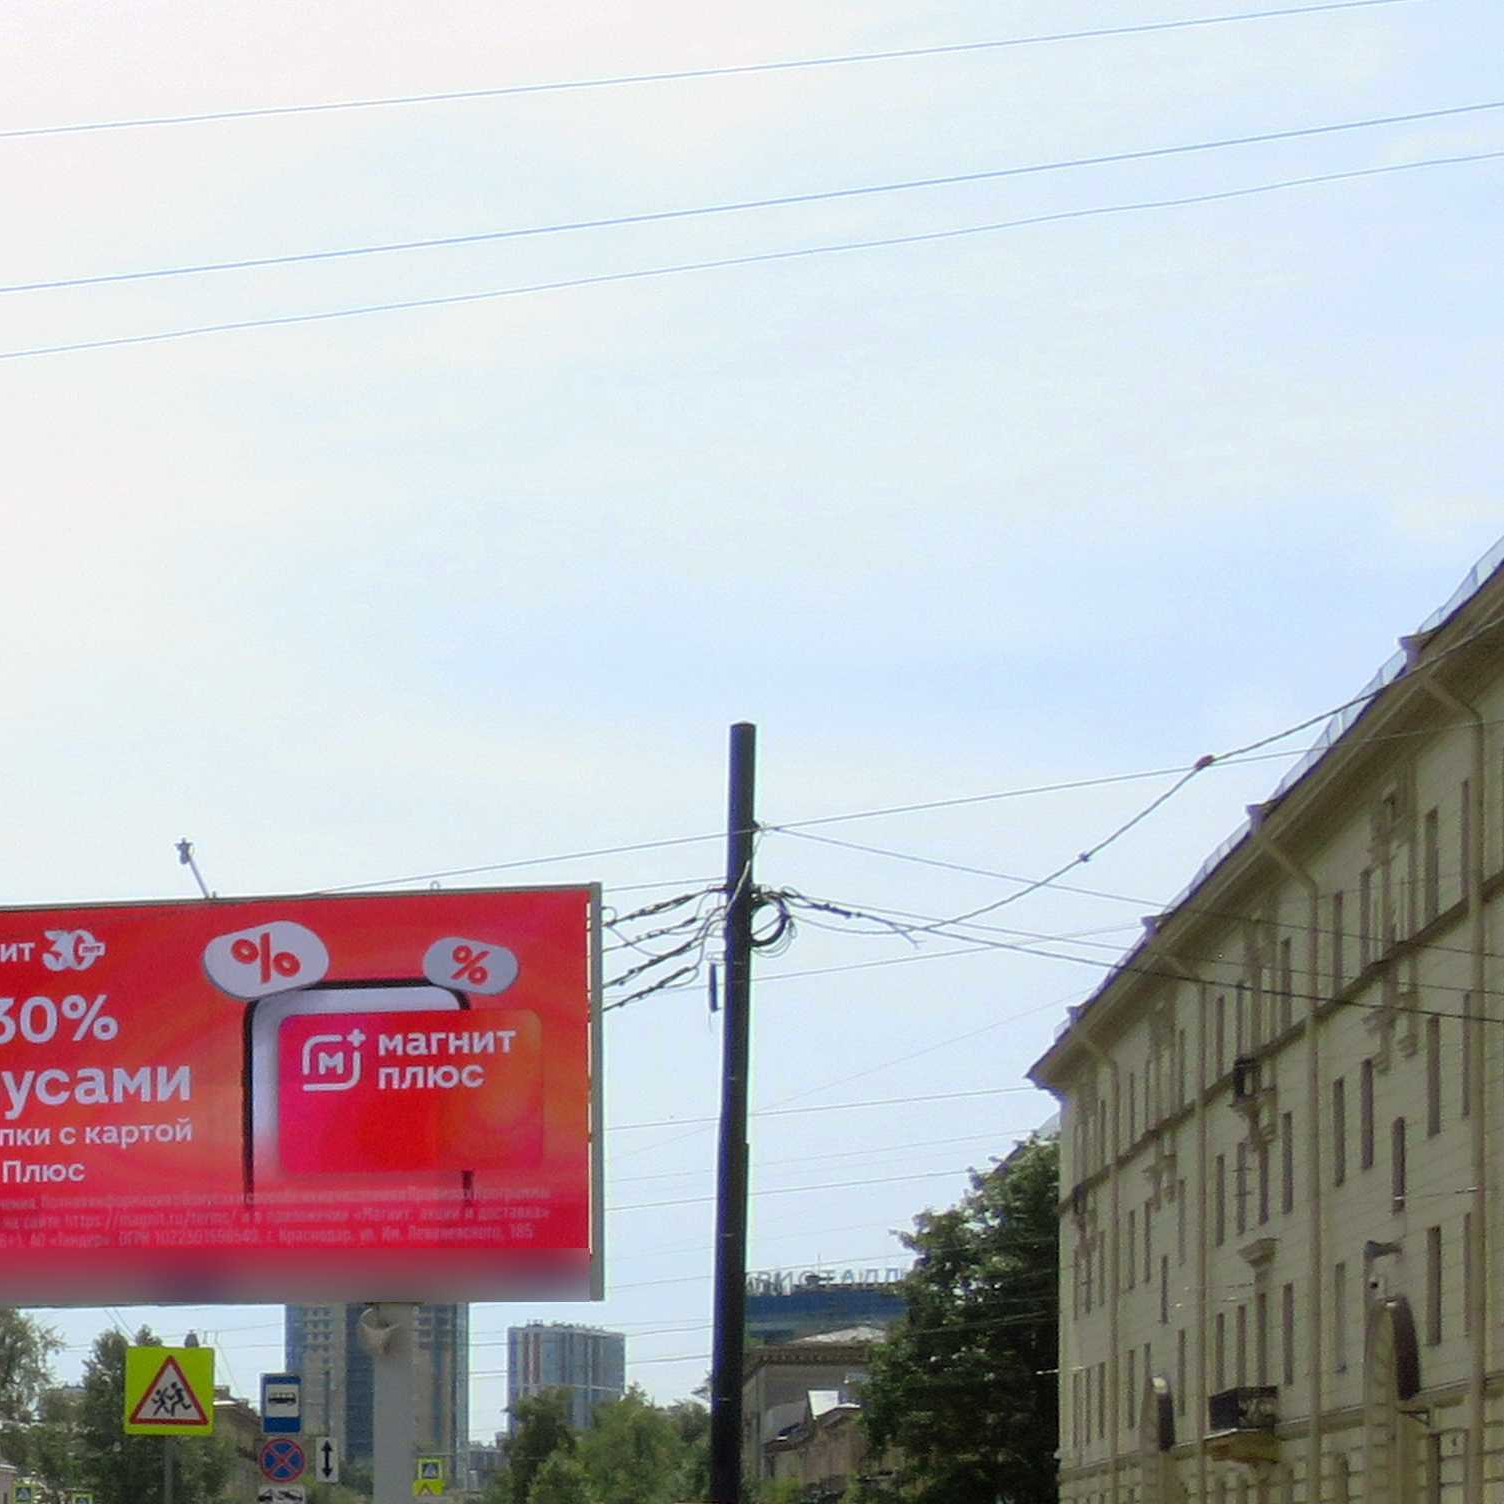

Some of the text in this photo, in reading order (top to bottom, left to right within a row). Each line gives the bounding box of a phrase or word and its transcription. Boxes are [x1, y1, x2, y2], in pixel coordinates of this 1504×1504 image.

[378, 1030, 516, 1056] магнит
[378, 1065, 485, 1090] плюс
[59, 1126, 76, 1145] с
[85, 1118, 193, 1149] картой
[2, 1160, 85, 1183] Плюс
